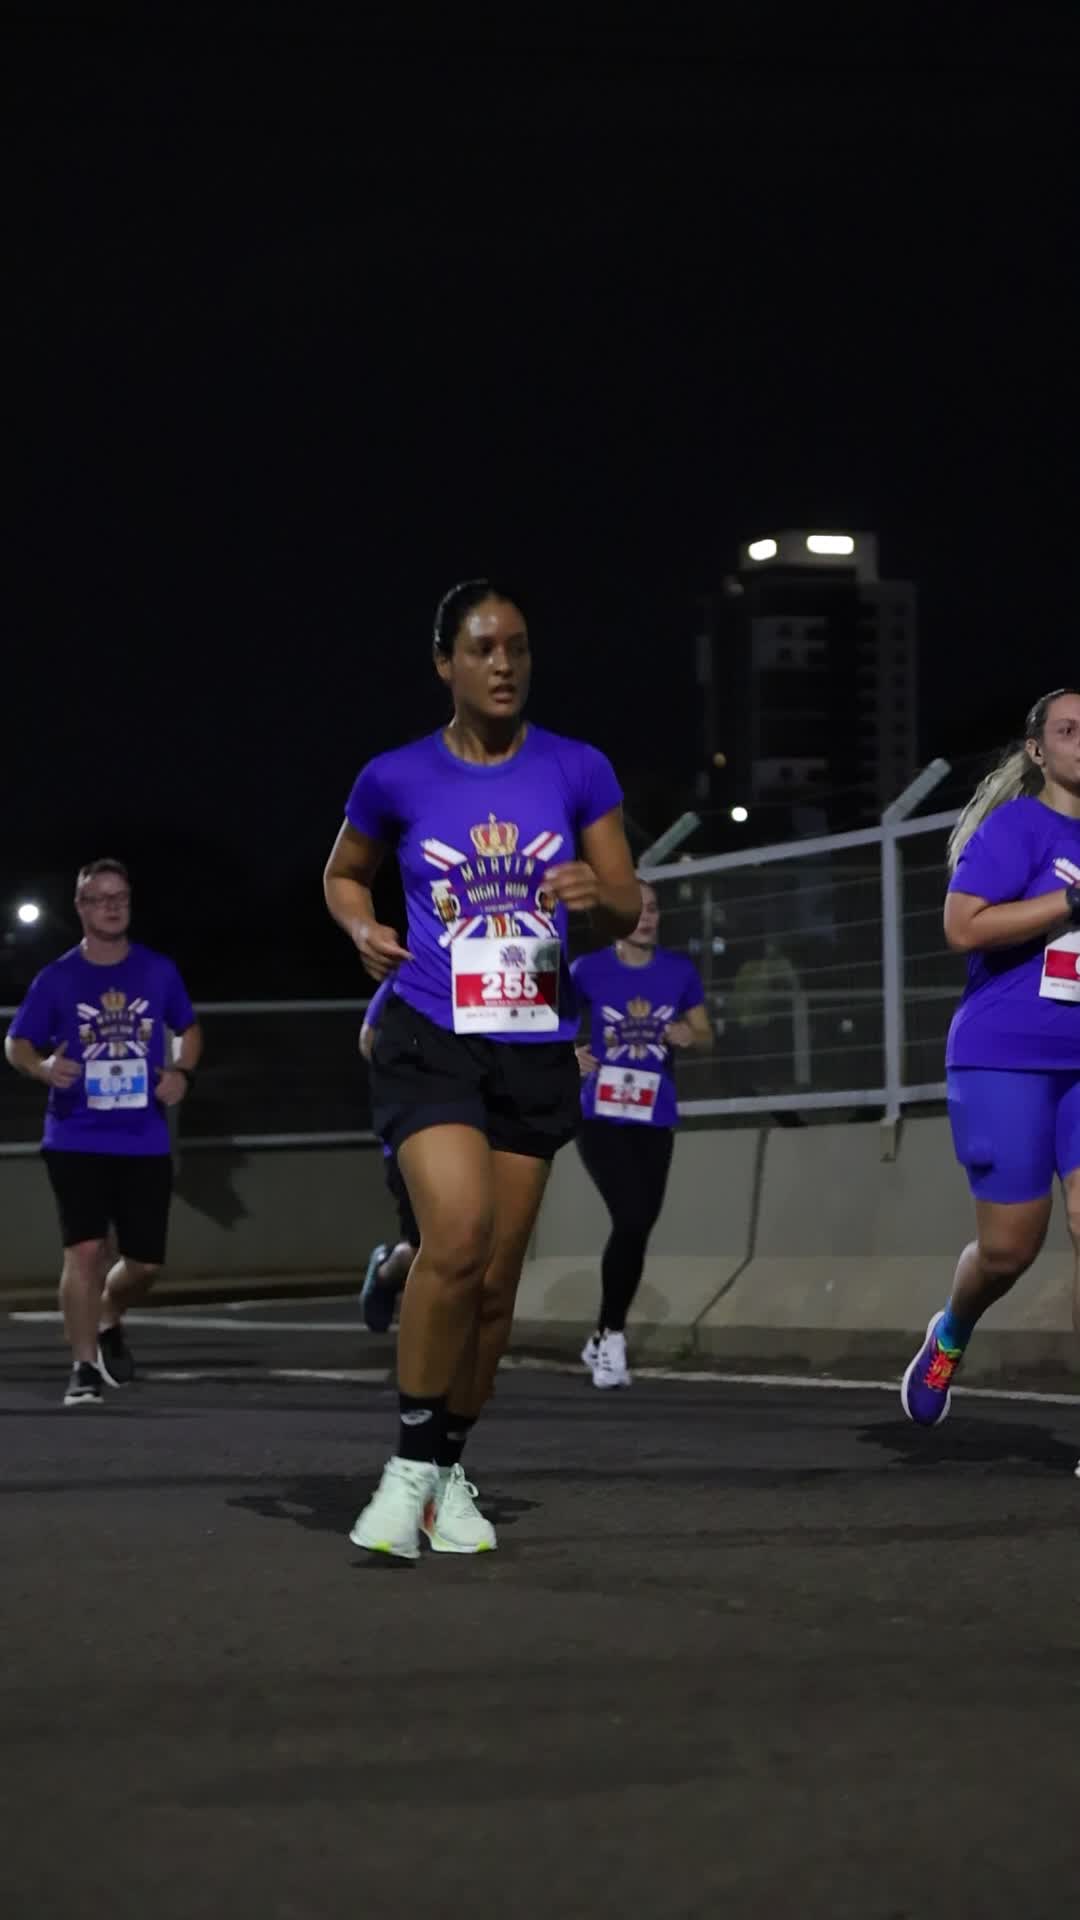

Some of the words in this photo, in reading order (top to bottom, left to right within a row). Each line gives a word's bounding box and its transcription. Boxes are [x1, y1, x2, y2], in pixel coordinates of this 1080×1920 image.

[460, 855, 535, 882] MARVIN
[467, 881, 500, 904] NIGHT
[505, 881, 529, 899] RUN
[481, 972, 539, 1000] 255
